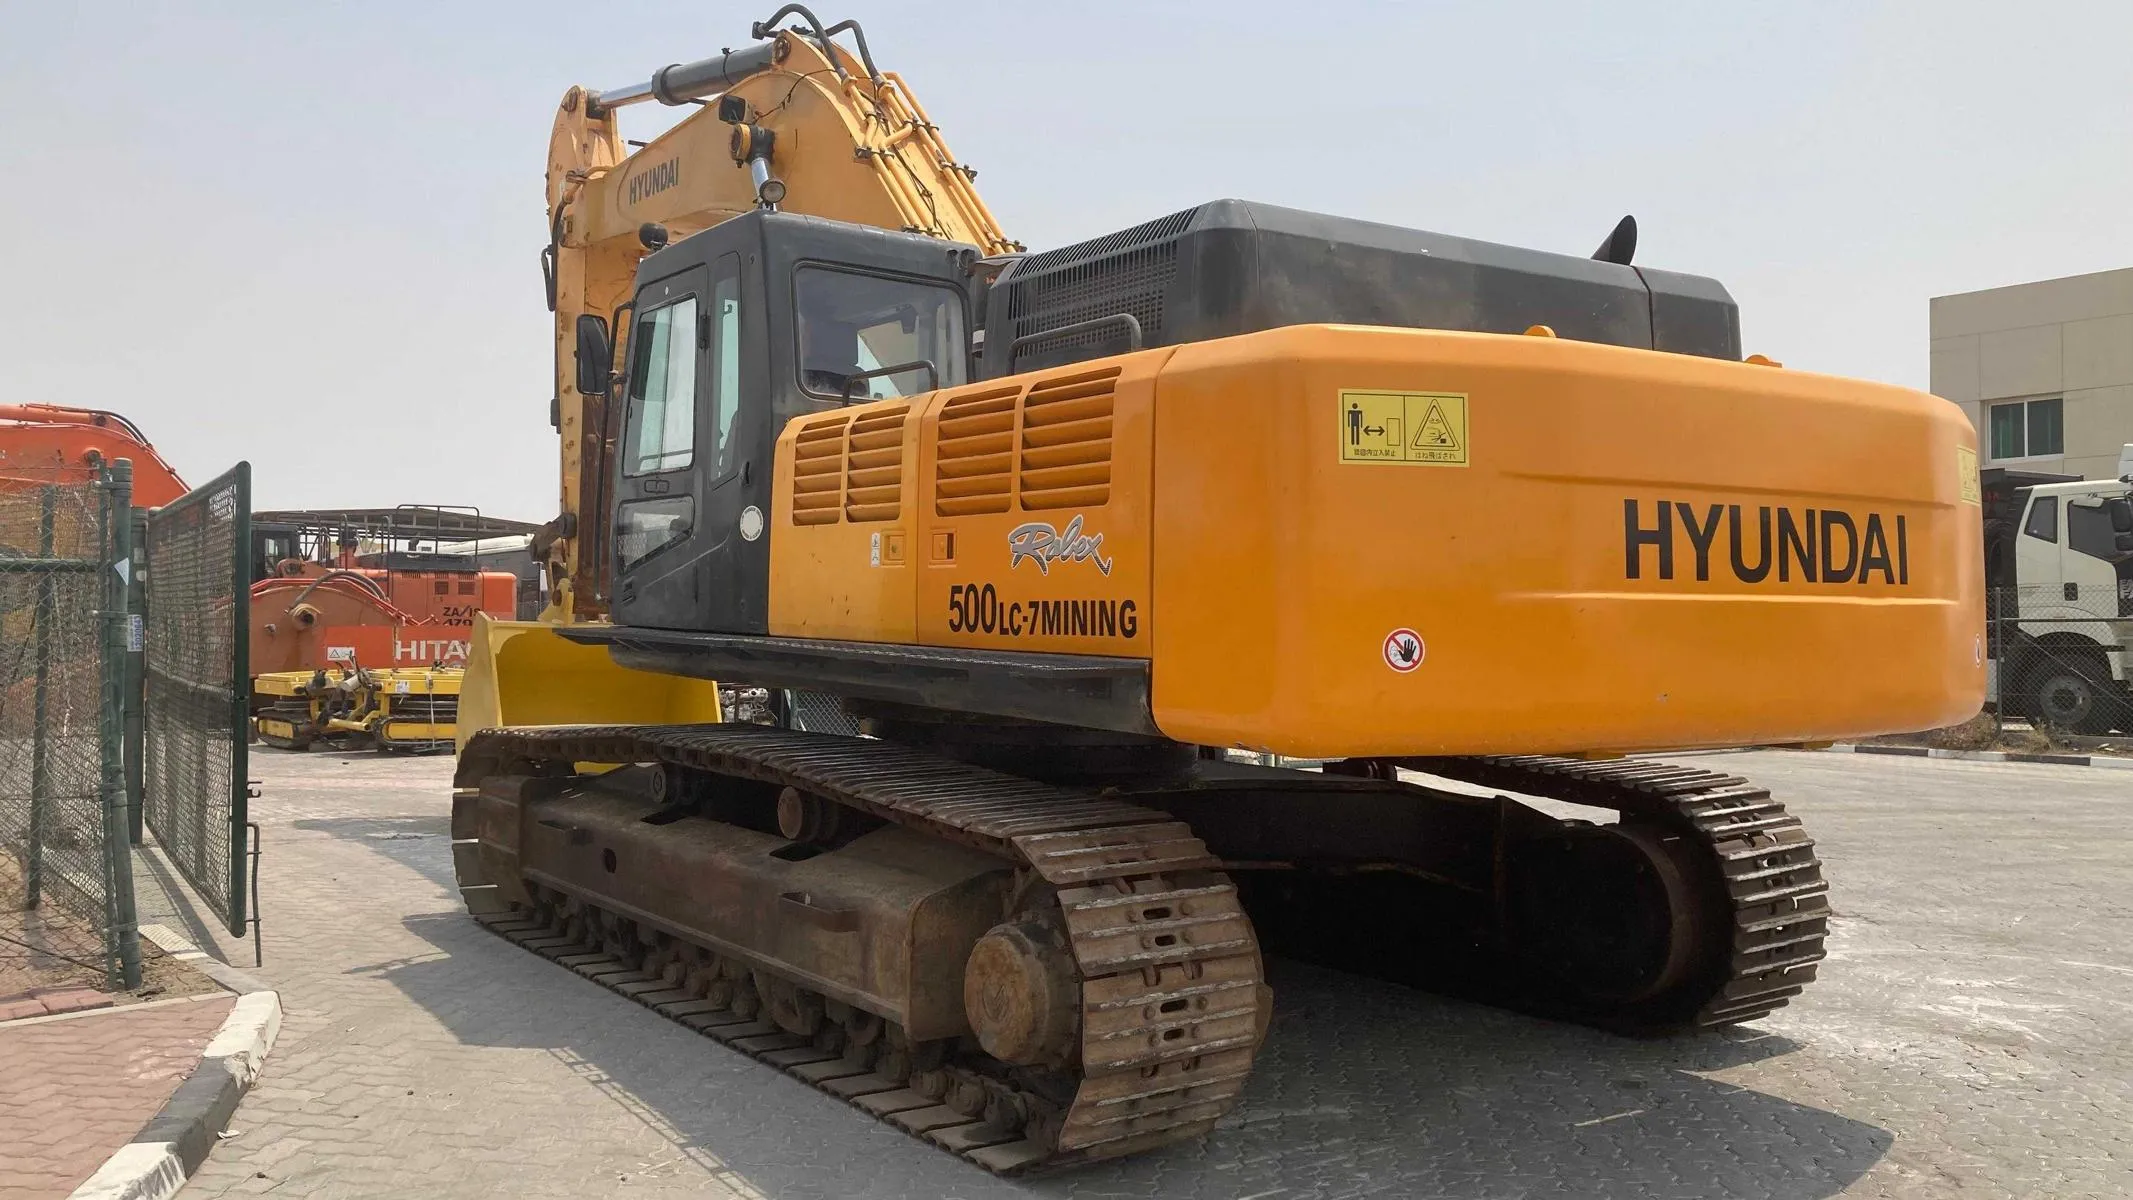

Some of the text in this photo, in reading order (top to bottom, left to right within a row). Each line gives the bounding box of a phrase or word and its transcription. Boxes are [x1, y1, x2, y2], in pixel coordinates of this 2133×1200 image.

[629, 156, 679, 206] HYUNDAI
[1624, 498, 1908, 585] HYUNDAI
[395, 639, 472, 661] HITA
